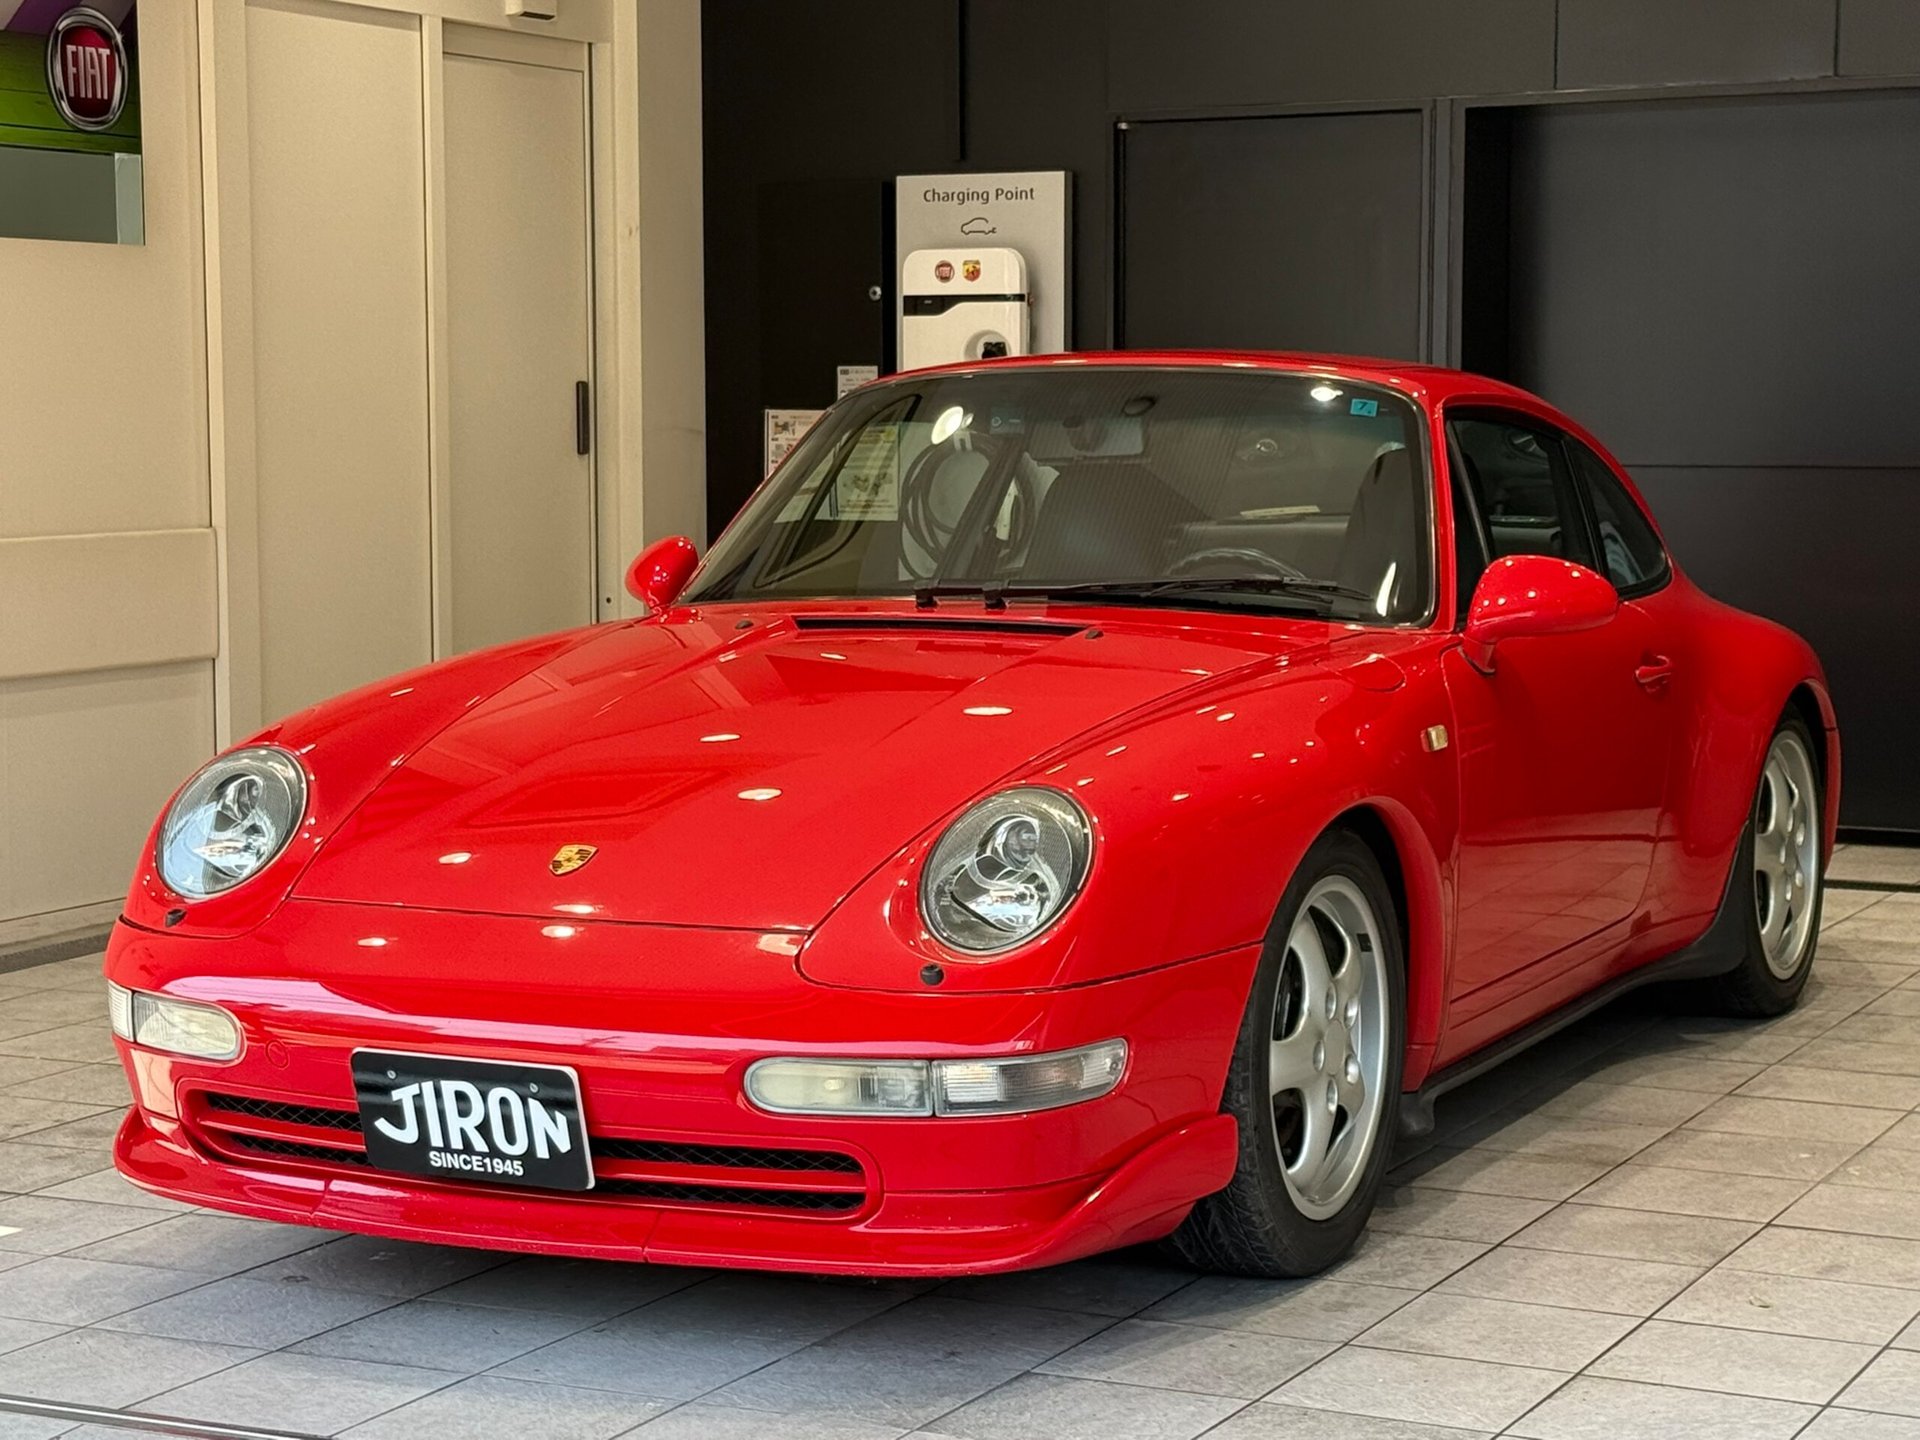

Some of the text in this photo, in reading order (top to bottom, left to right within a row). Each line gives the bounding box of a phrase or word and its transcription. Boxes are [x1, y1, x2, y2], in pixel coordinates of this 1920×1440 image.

[66, 44, 111, 100] FIAT
[923, 186, 1035, 206] Charging Point
[374, 1079, 572, 1160] JIRON
